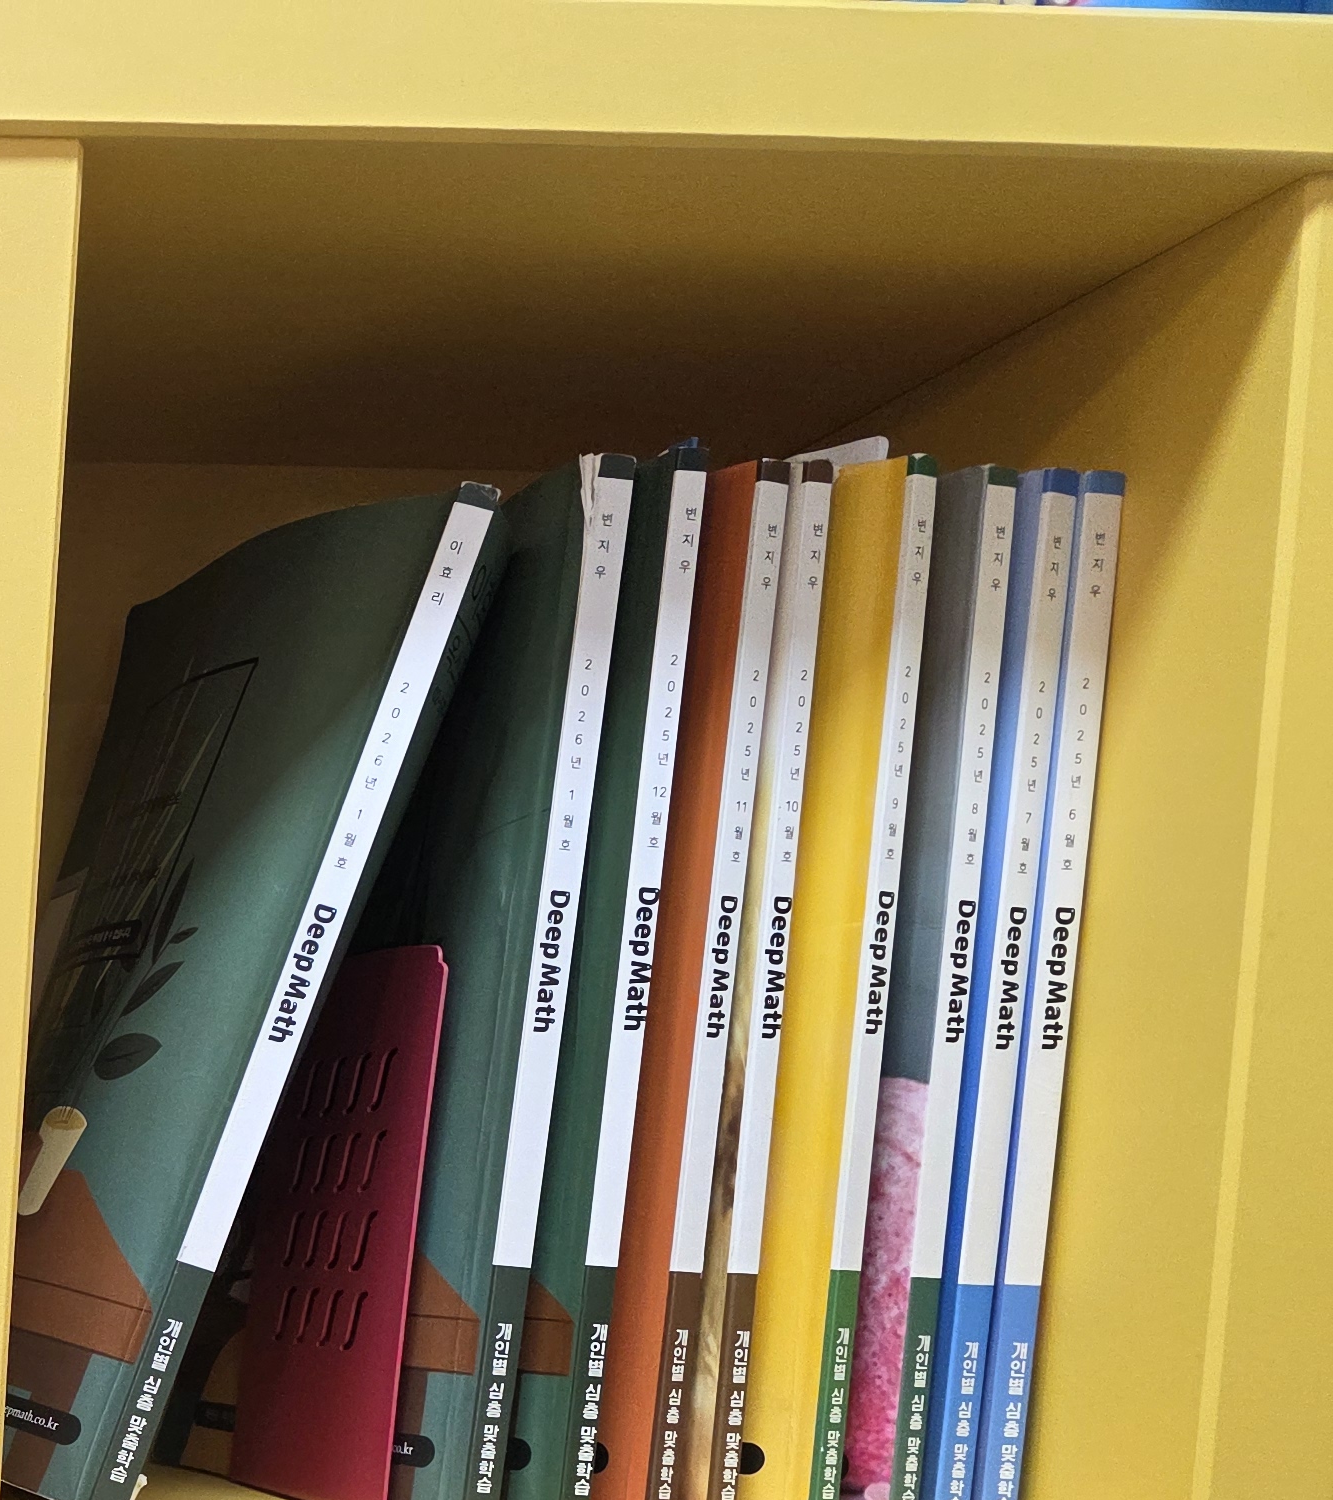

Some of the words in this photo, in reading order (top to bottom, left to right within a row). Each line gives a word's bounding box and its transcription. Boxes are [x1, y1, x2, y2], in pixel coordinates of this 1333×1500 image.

[678, 507, 698, 575] 변지우
[1088, 532, 1107, 599] 변지우
[430, 540, 464, 607] 이효리
[150, 1318, 185, 1374] 개인별
[587, 1323, 610, 1379] 개인별
[1007, 1341, 1029, 1397] 개인별
[135, 1375, 163, 1413] 심층
[582, 1383, 603, 1421] 심층
[1003, 1401, 1023, 1439] 심층
[109, 1414, 149, 1485] 맞춤학습
[573, 1425, 599, 1498] 맞춤학습
